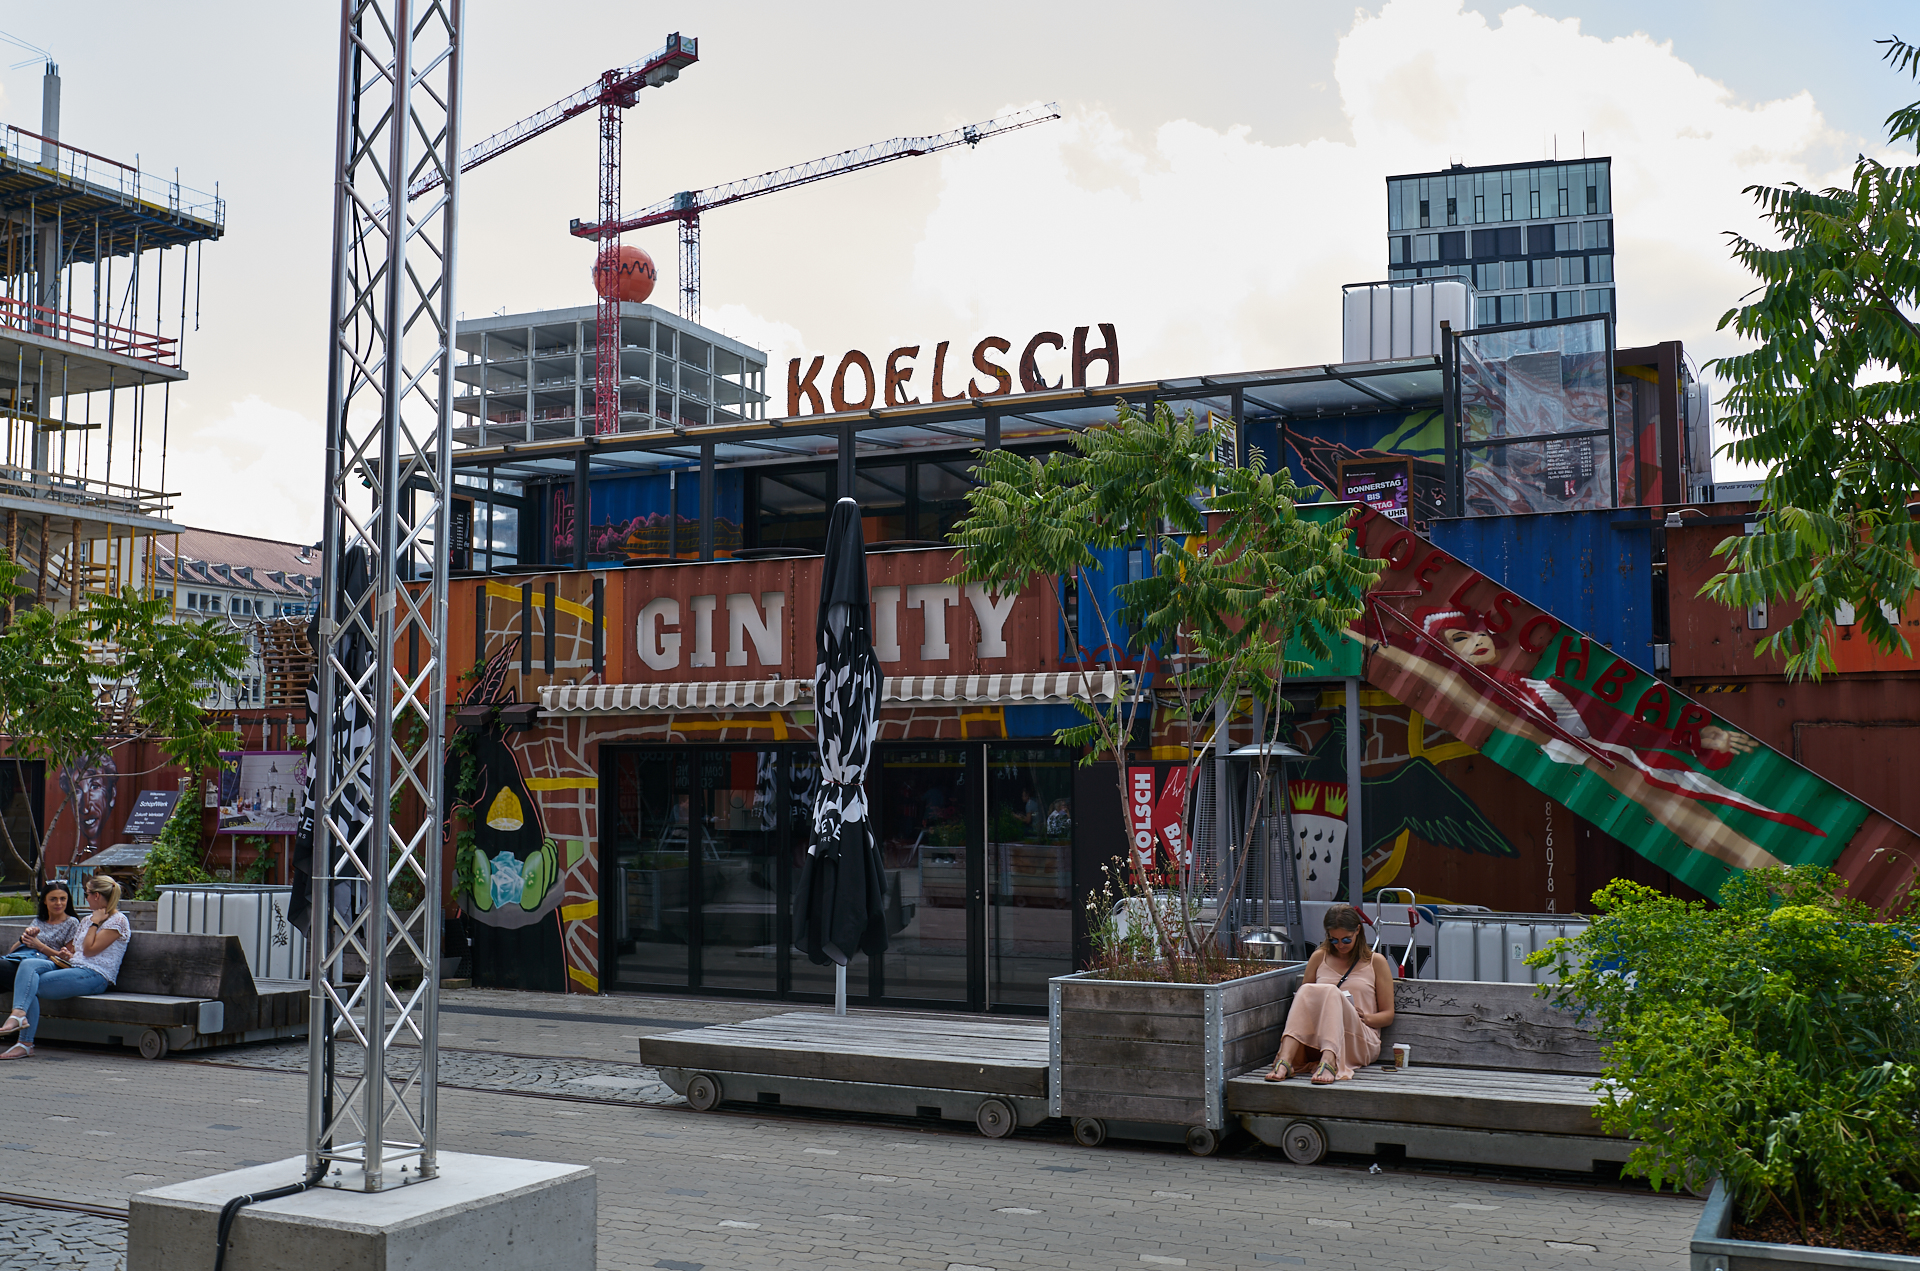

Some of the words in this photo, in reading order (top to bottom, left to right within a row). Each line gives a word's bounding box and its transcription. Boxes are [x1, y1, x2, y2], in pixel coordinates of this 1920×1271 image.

[787, 323, 1120, 417] KOELSCH
[1347, 480, 1402, 495] DONNERSTAG
[1367, 492, 1381, 501] BIS
[1387, 508, 1406, 518] UHR
[636, 591, 785, 671] GIN
[871, 579, 1020, 663] ITY
